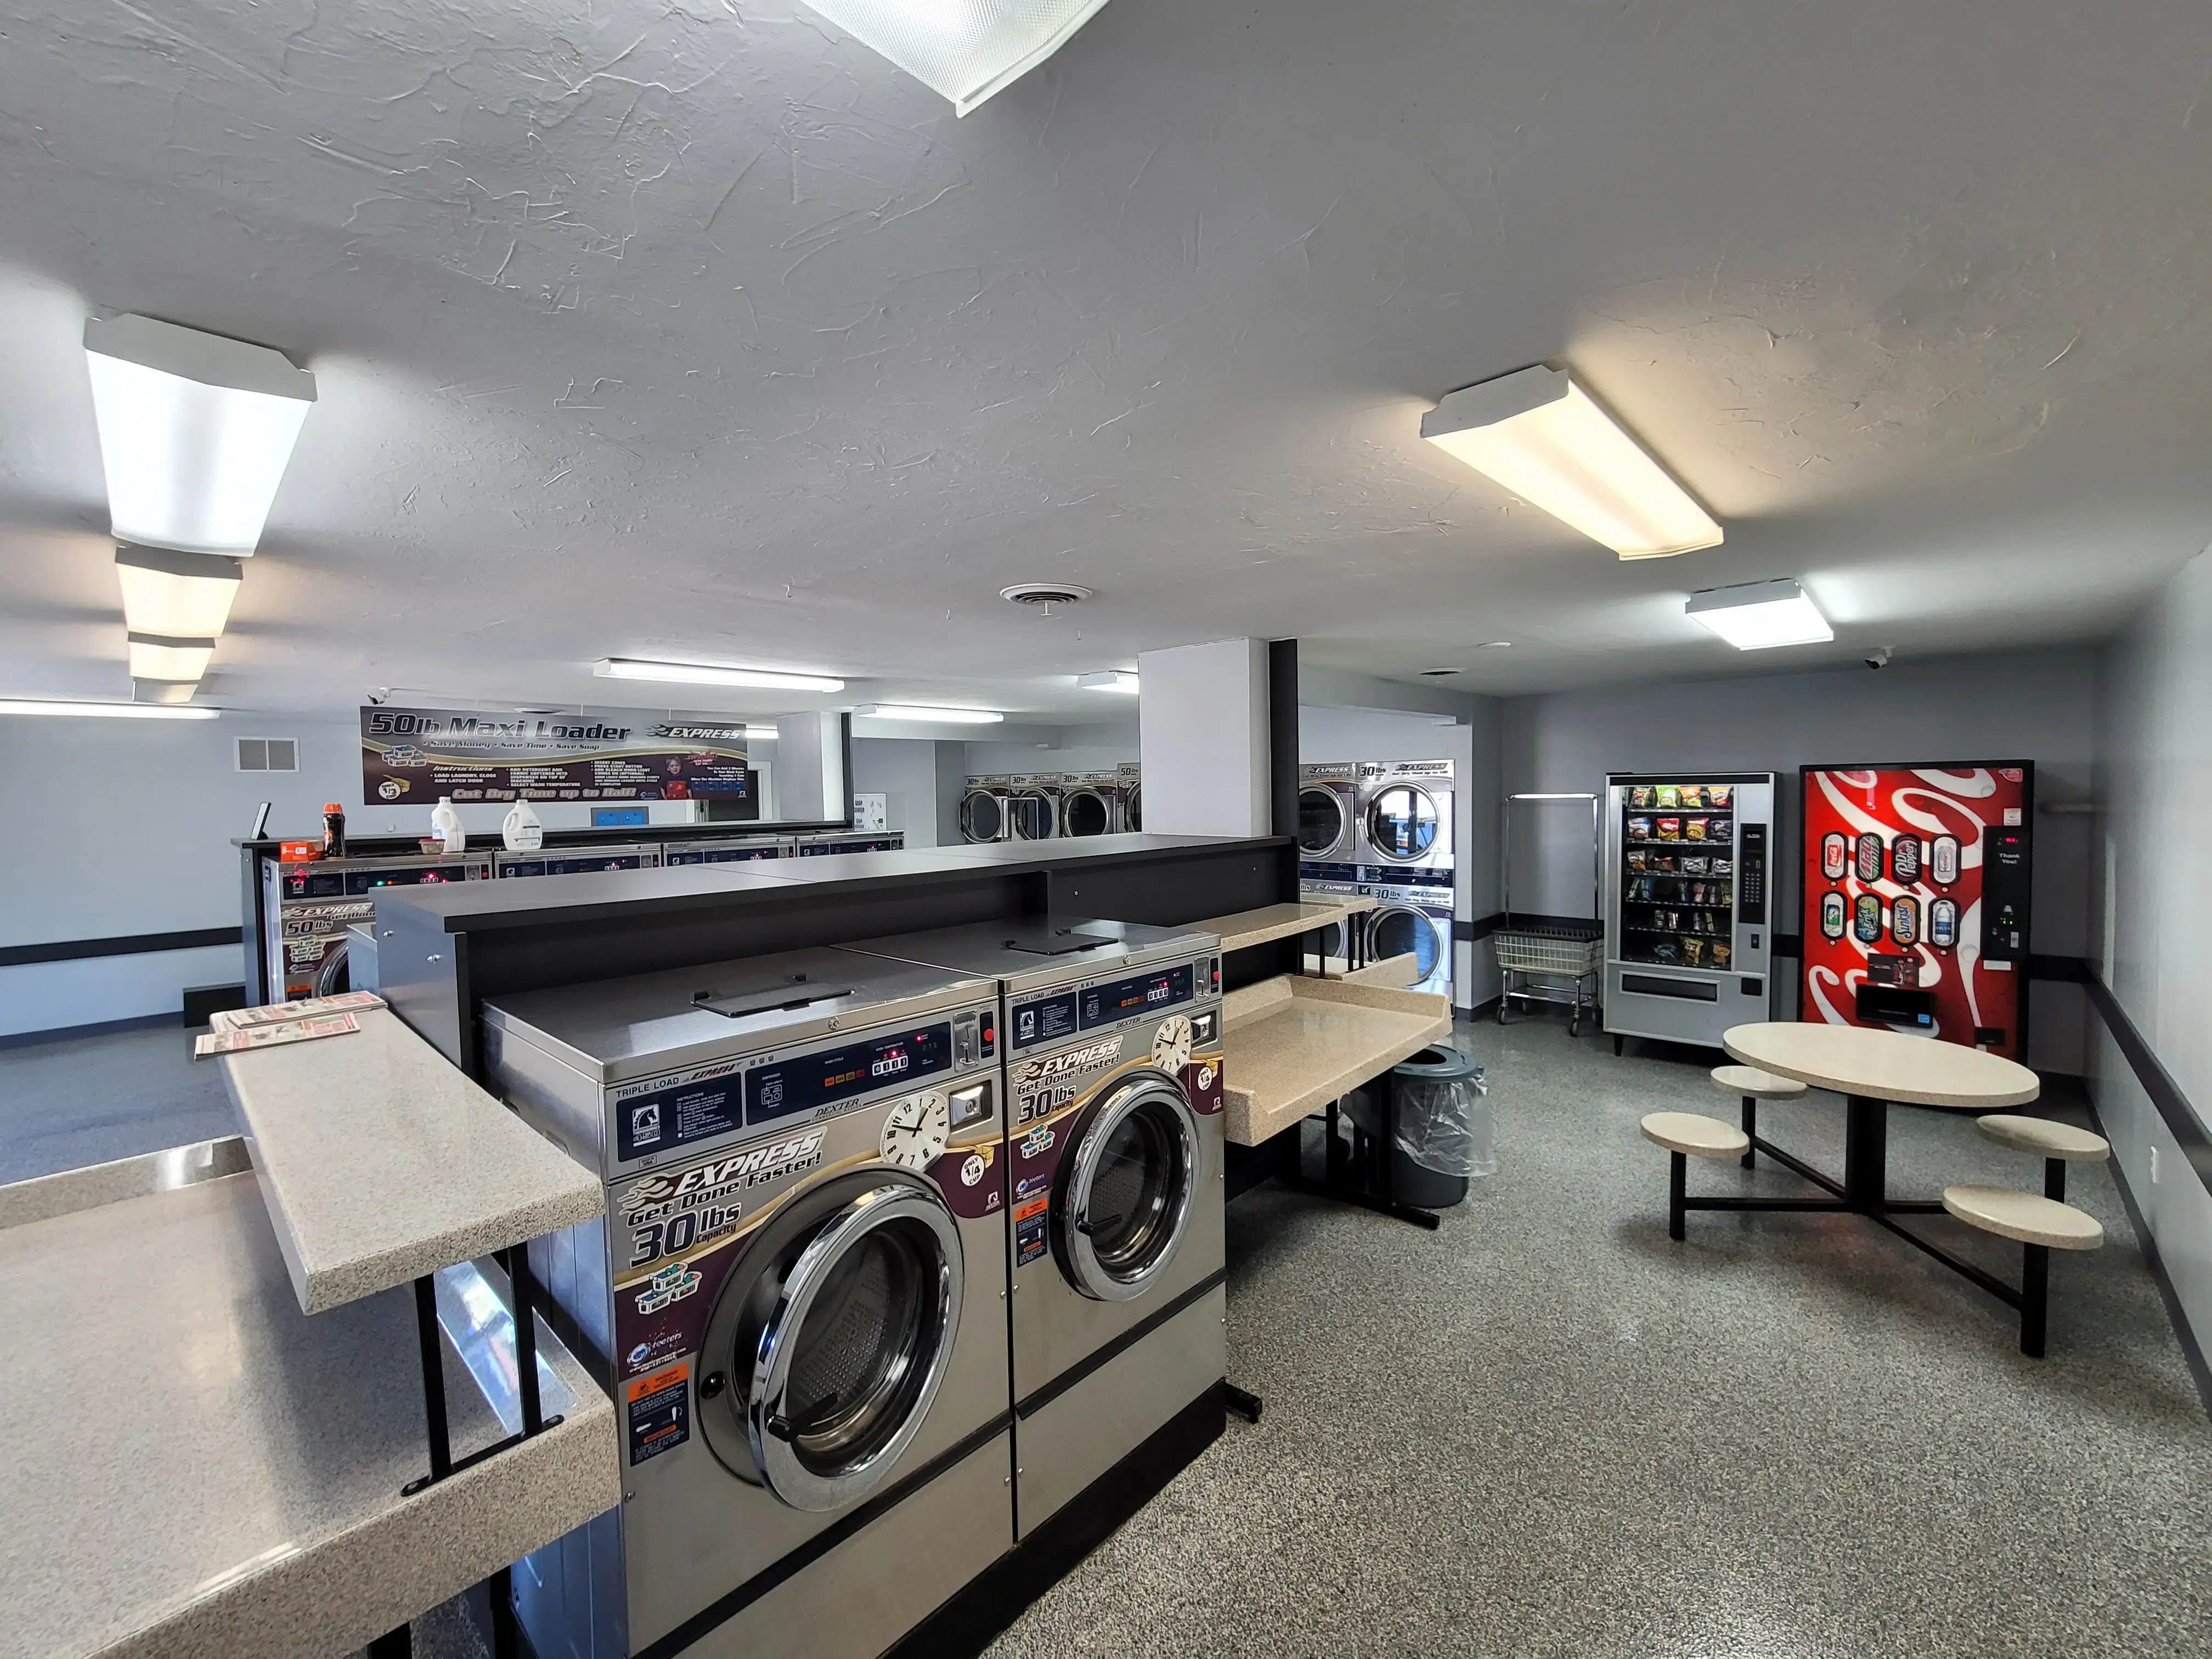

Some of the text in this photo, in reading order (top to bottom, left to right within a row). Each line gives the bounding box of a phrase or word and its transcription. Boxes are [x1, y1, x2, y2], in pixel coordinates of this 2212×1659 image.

[369, 713, 631, 741] 50lb Maxi Loader
[668, 727, 742, 740] EXPRESS
[1120, 768, 1131, 776] 50
[1359, 766, 1375, 776] 30
[452, 788, 483, 799] Cut
[485, 788, 516, 800] Dry
[520, 788, 556, 798] Time
[559, 789, 579, 799] up
[1895, 840, 1918, 876] Pepper
[1373, 889, 1389, 899] 30
[303, 905, 371, 916] EXPRESS
[286, 920, 333, 935] 50 lbs
[1895, 904, 1912, 939] Sunkist
[1012, 996, 1029, 1005] TRIPLE
[1050, 985, 1074, 996] EXPRESS
[1115, 1017, 1141, 1029] DEXTER
[1041, 1039, 1121, 1077] EXPRESS
[616, 1063, 736, 1098] TRIPLE LOAD EXPRESS
[1018, 1056, 1120, 1095] Get Done Faster!
[815, 1098, 859, 1118] DEXTER
[904, 1103, 912, 1114] 12
[919, 1098, 923, 1107] 1
[928, 1099, 936, 1109] 2
[1018, 1085, 1076, 1125] 30 lbs
[1052, 1100, 1074, 1111] Capacity
[812, 1104, 862, 1121] COMMERCIAL WASHER
[935, 1107, 945, 1115] 3
[893, 1116, 902, 1124] 11
[887, 1130, 896, 1139] 10
[887, 1145, 897, 1154] 9
[922, 1148, 929, 1159] 6
[673, 1132, 823, 1197] EXPRESS
[895, 1153, 904, 1164] 8
[910, 1154, 915, 1166] 7
[964, 1156, 978, 1169] ONLY
[966, 1165, 980, 1177] 1/4
[969, 1174, 980, 1184] CUP
[629, 1152, 822, 1226] Get Done Faster!
[630, 1203, 741, 1268] 30 lbs
[697, 1224, 737, 1244] Capacity
